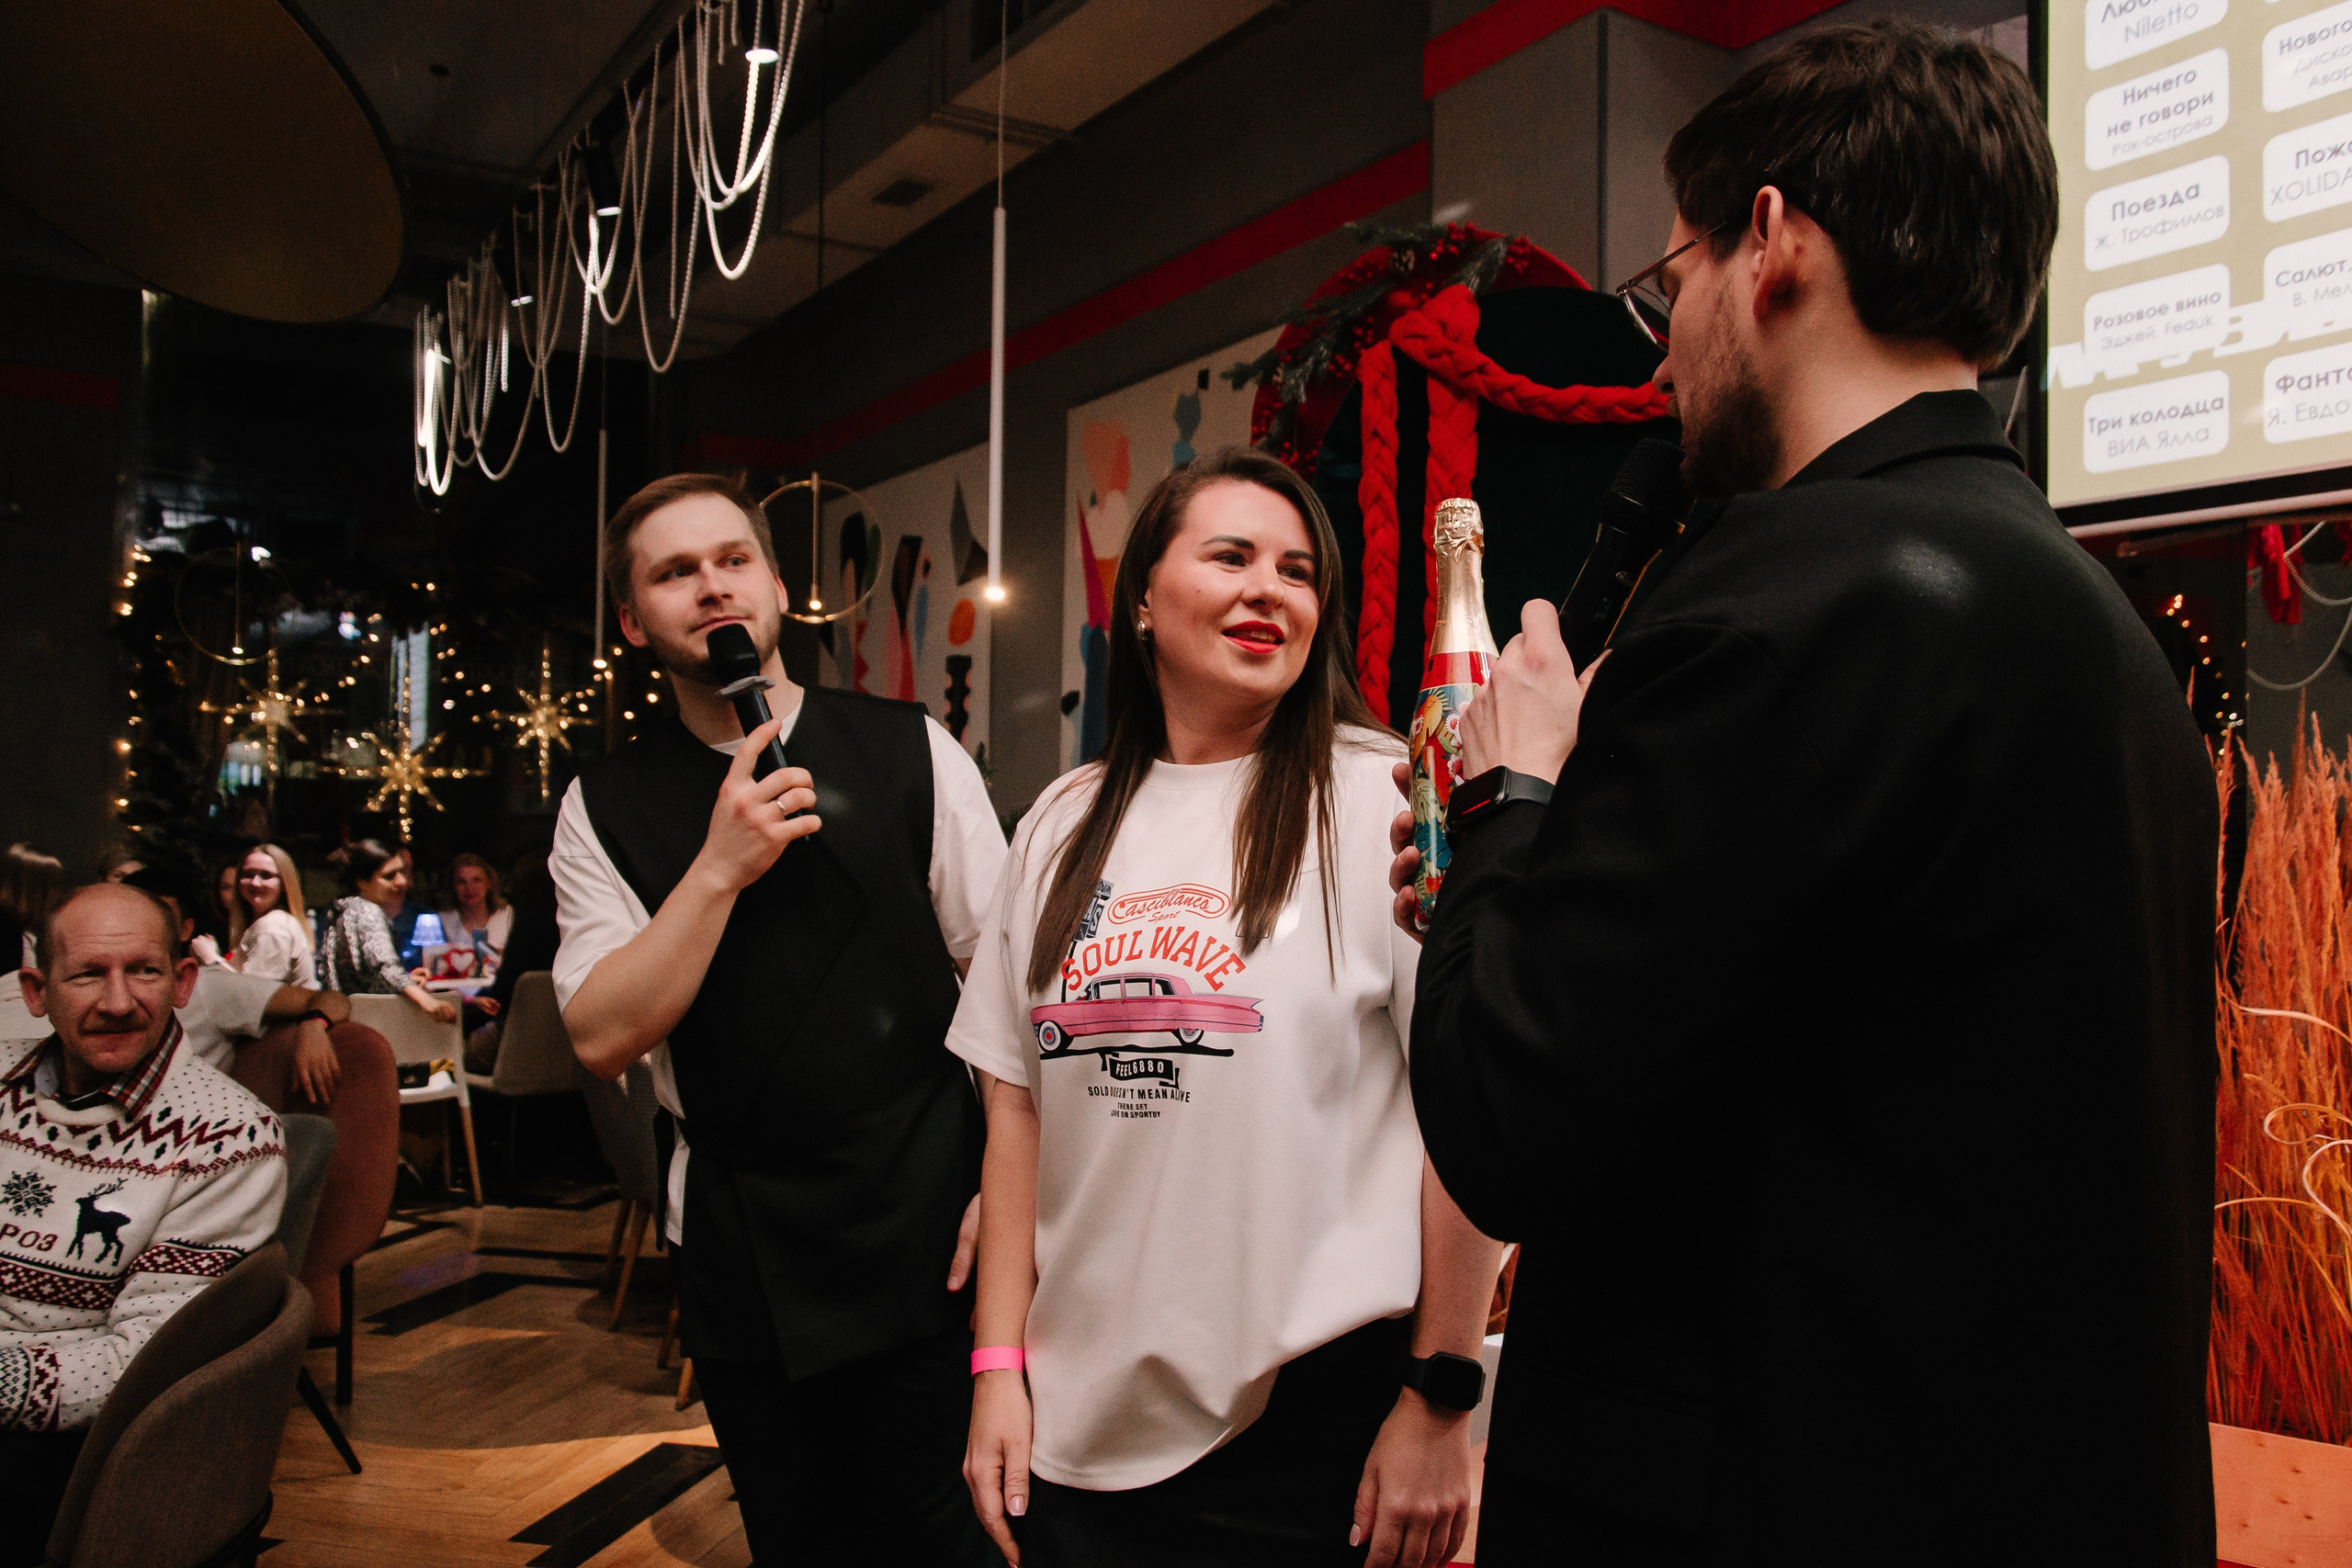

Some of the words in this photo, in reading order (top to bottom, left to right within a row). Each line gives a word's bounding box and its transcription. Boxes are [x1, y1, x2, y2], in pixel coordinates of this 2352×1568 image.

[2124, 3, 2199, 43] Niletto
[2122, 70, 2197, 106] Ничего
[2107, 119, 2132, 138] не
[2139, 92, 2213, 128] говори
[2112, 115, 2213, 156] Рок-острова
[2111, 183, 2199, 222] Поезда
[2121, 204, 2224, 244] Трофимов
[2094, 303, 2169, 332] Розовое
[2176, 291, 2222, 312] вино
[2165, 314, 2213, 335] Feduk
[2088, 416, 2122, 436] Три
[2130, 396, 2224, 426] колодца
[2267, 408, 2287, 428] Я.
[2108, 434, 2151, 457] ВИА
[2157, 427, 2210, 449] Ялла
[1061, 930, 1143, 991] SOUL
[1149, 926, 1247, 992] WAVE
[1087, 1086, 1109, 1097] SOLD
[1137, 1088, 1168, 1100] MEAN
